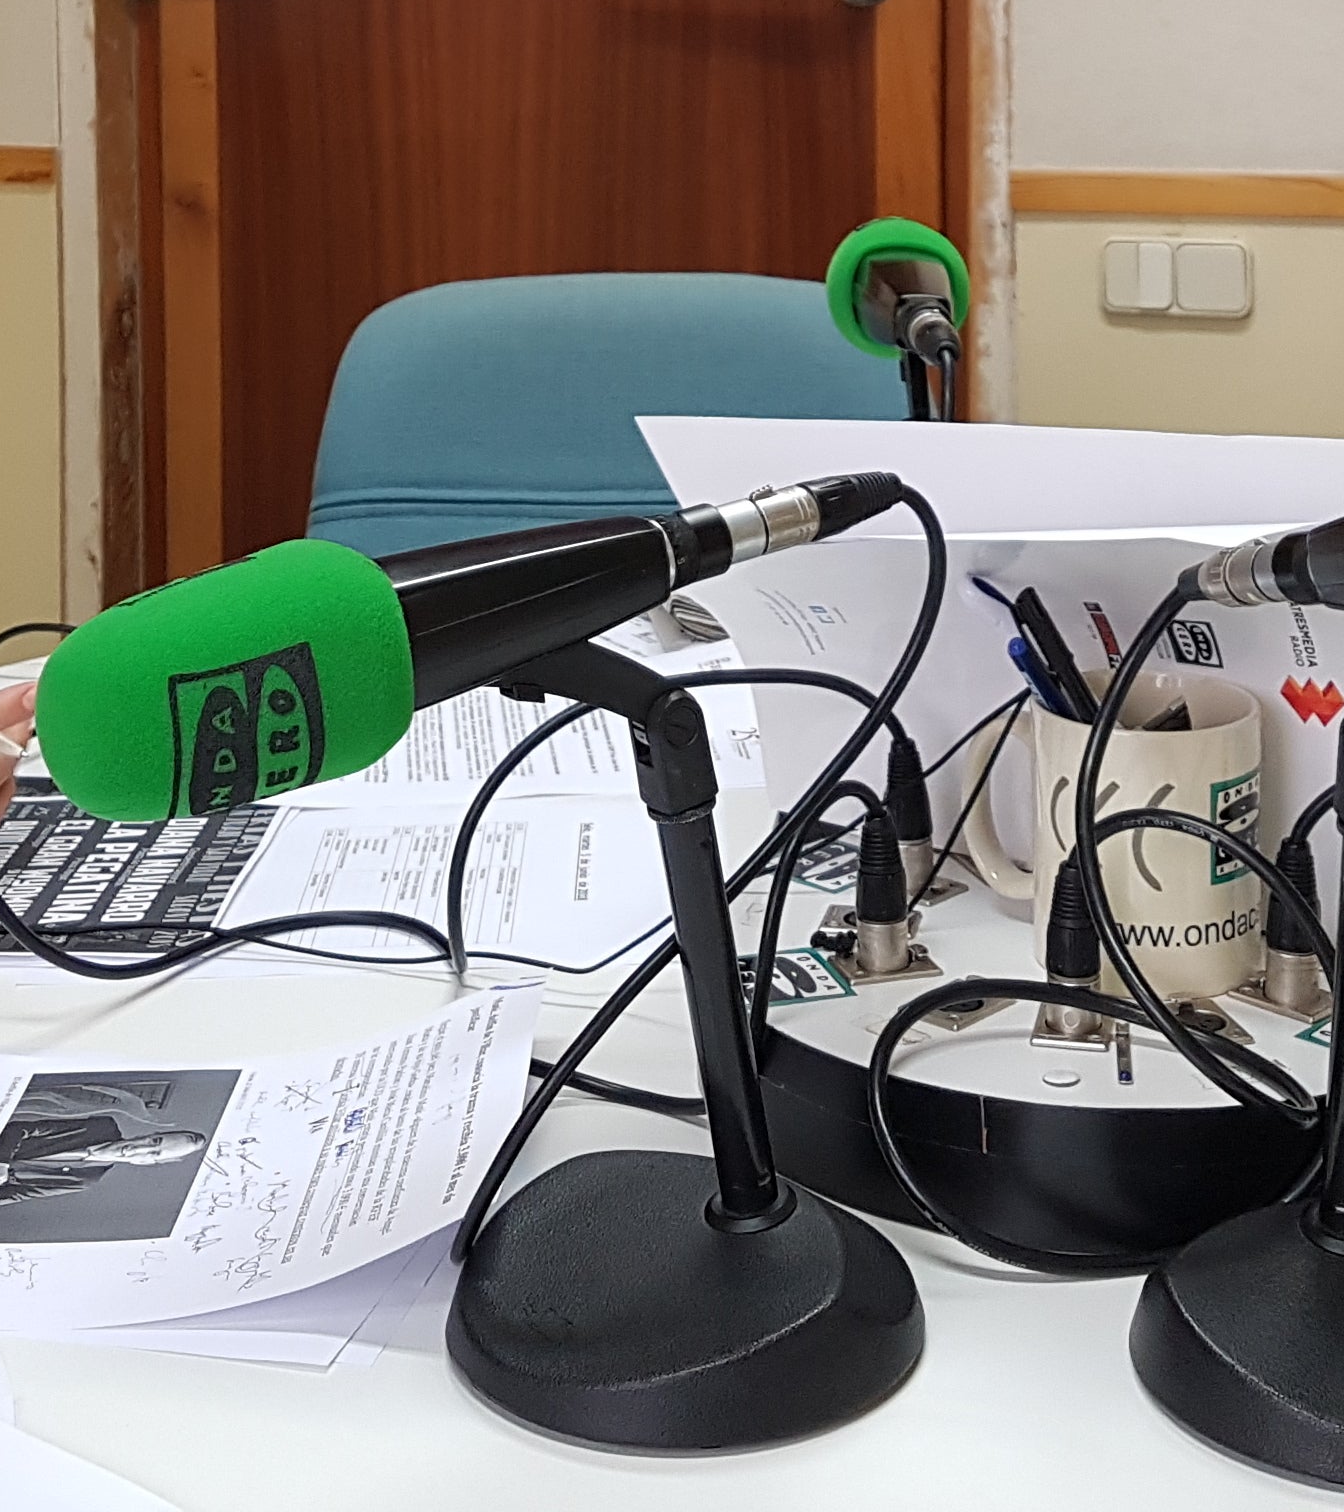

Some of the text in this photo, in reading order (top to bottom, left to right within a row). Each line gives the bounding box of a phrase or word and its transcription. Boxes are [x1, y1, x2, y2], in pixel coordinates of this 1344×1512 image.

[1172, 624, 1194, 660] CERO
[1189, 625, 1213, 661] ONDA
[1289, 636, 1305, 668] RADIO
[52, 819, 96, 833] EL
[146, 817, 209, 857] DIANA
[27, 835, 84, 866] GRAN
[38, 842, 140, 924] PEGATINA
[101, 858, 181, 922] NAVARRO
[1116, 908, 1259, 947] ww.ondac
[796, 956, 840, 991] ONDA
